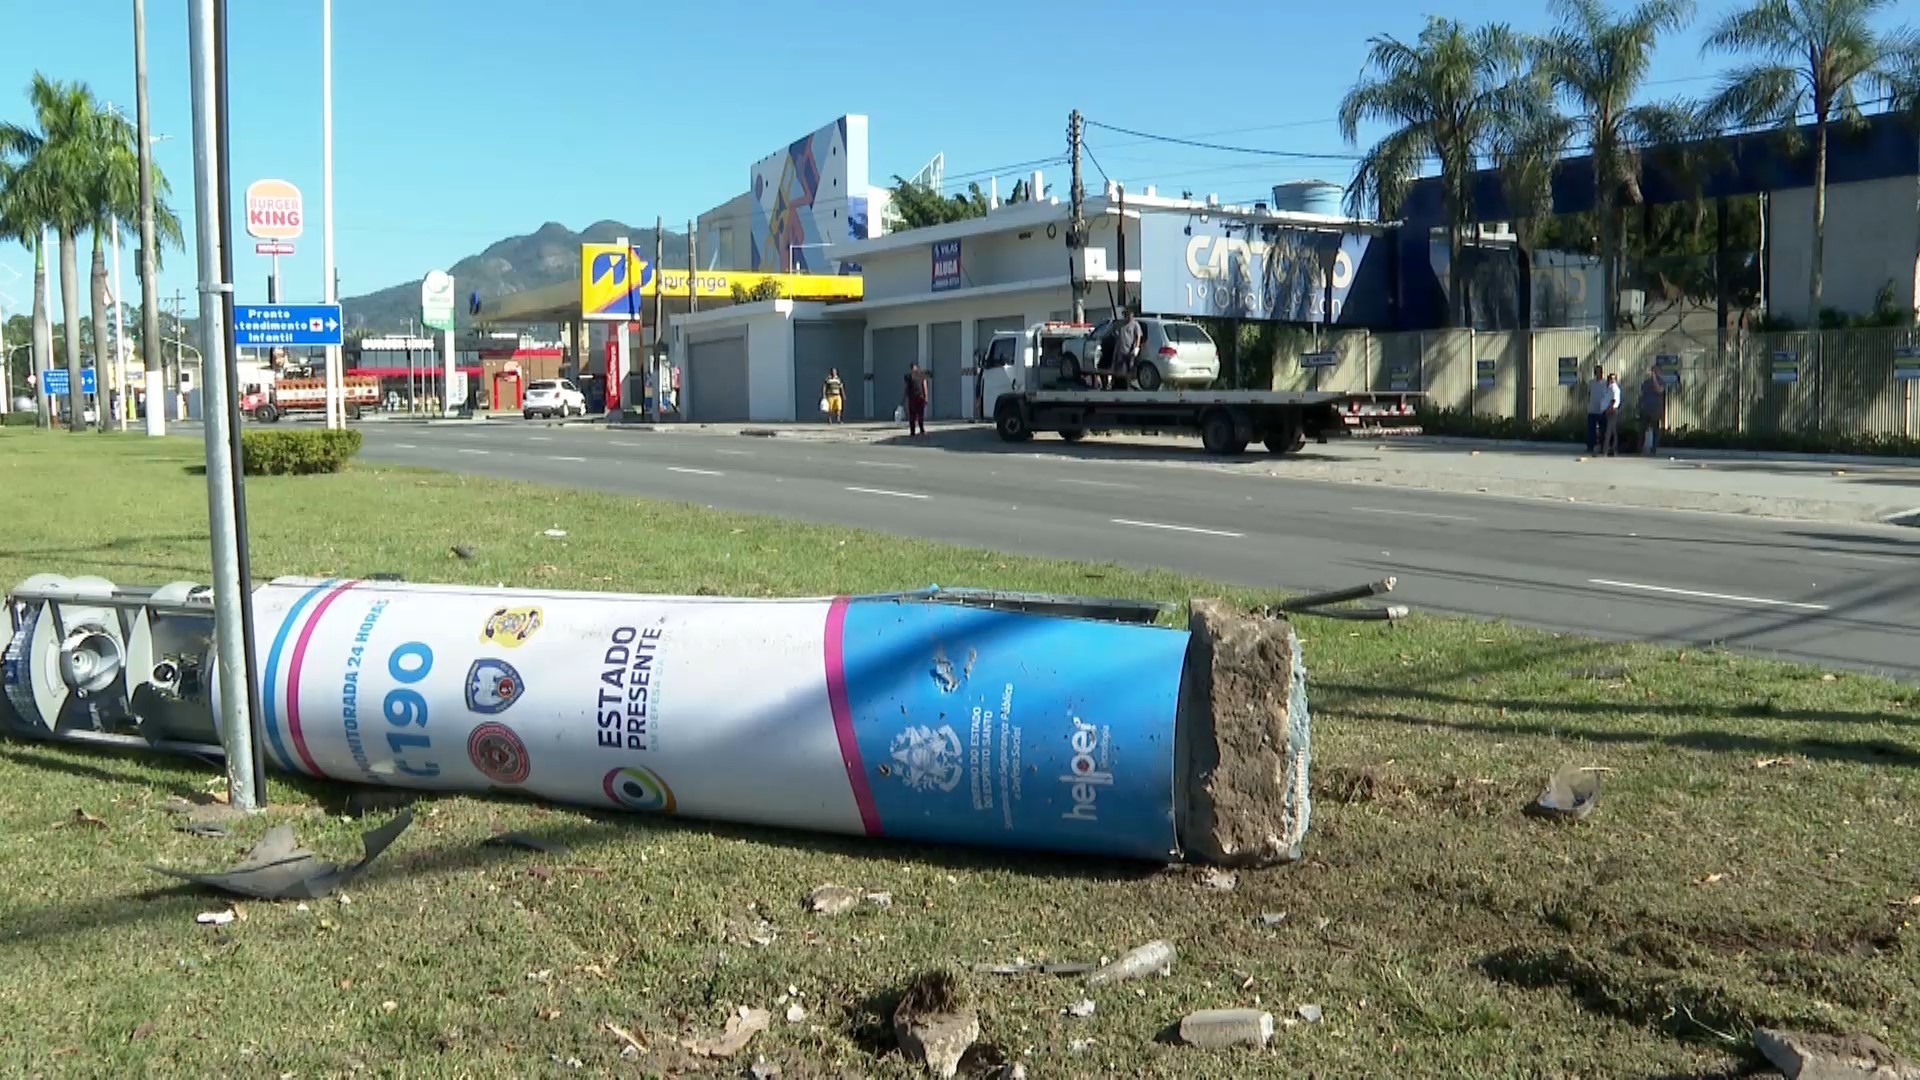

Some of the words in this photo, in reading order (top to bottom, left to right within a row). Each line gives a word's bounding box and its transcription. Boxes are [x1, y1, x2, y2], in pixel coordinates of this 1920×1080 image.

[250, 198, 299, 210] BURGER
[251, 211, 300, 226] KING
[934, 259, 958, 277] ALUGA
[1185, 235, 1353, 288] CARTO
[660, 275, 727, 292] pirnga
[248, 309, 290, 319] Pronto
[248, 333, 294, 343] Infantil
[347, 645, 365, 667] 24
[383, 641, 434, 754] 190
[597, 626, 637, 749] ESTADO
[627, 627, 662, 751] PRESENTE
[650, 679, 661, 731] DEFESA
[970, 706, 982, 746] ESTADO
[983, 710, 994, 746] SANTO
[970, 749, 980, 765] DO
[1059, 716, 1115, 821] helper
[970, 766, 984, 810] GOVERNO
